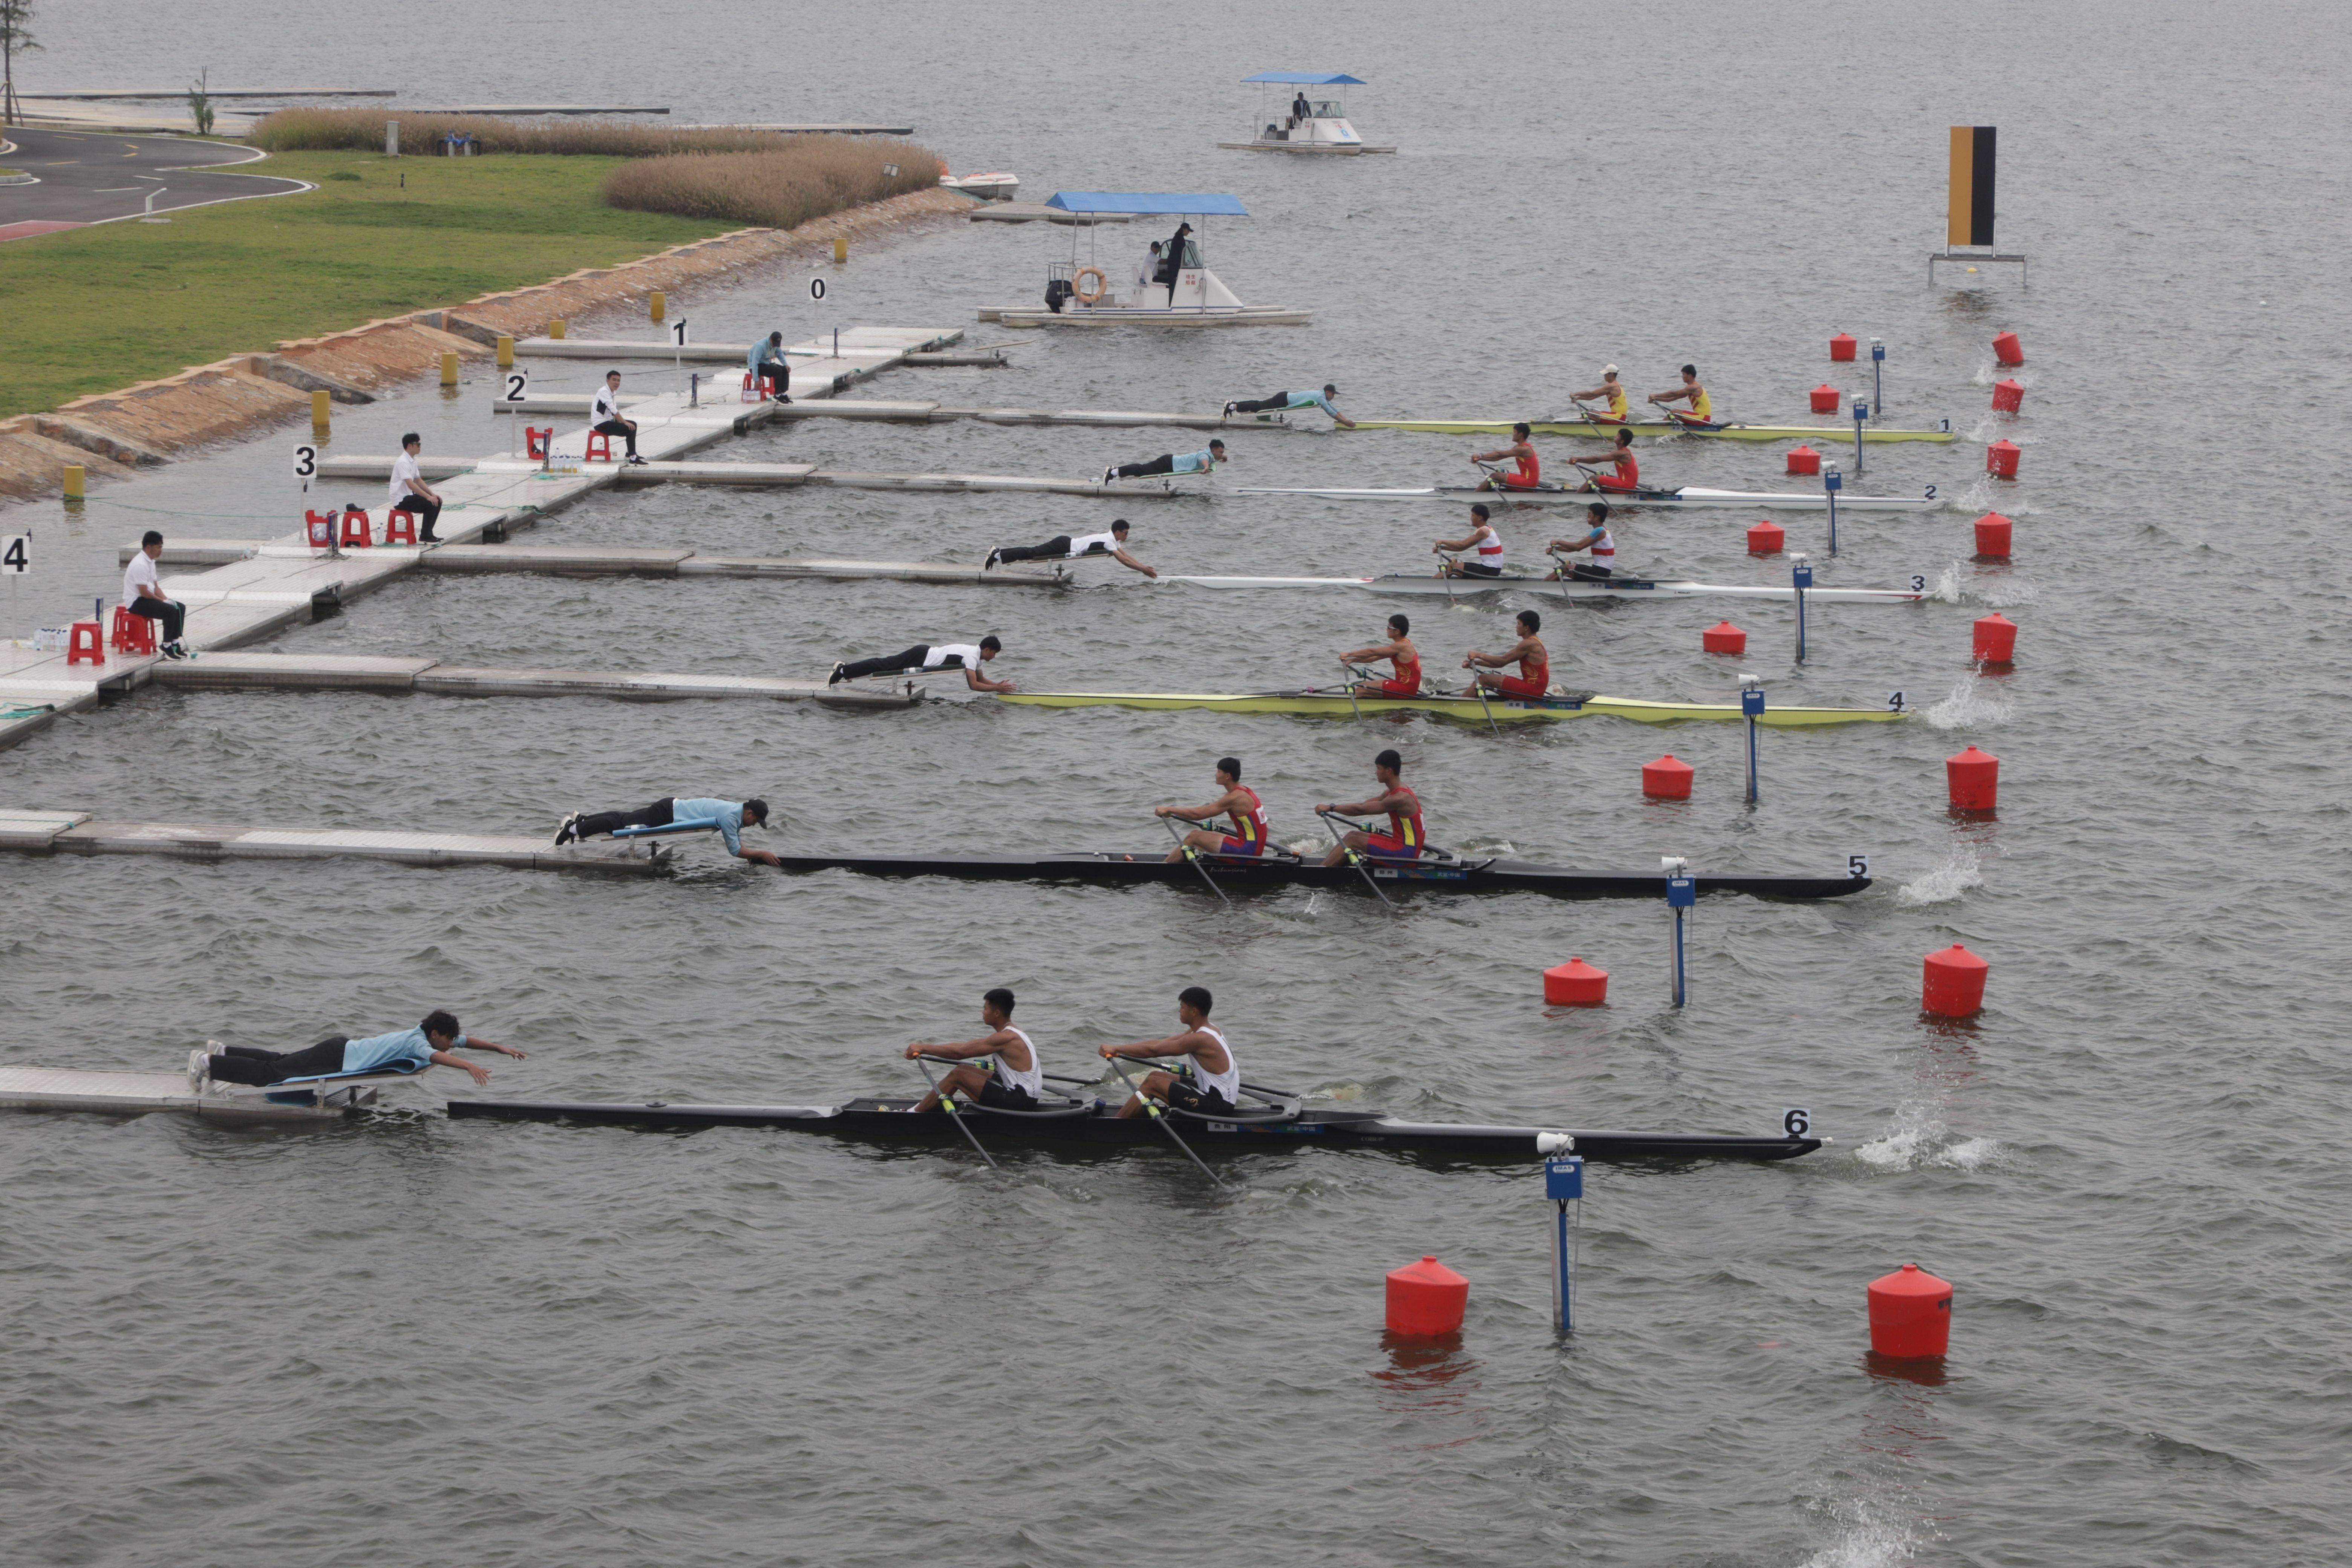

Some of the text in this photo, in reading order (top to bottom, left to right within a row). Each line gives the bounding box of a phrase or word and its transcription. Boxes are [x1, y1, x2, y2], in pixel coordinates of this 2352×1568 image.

[812, 279, 825, 299] 0
[674, 323, 684, 346] 1
[508, 376, 524, 401] 2
[1941, 419, 1949, 430] 1
[296, 447, 314, 475] 3
[1925, 485, 1936, 498] 2
[4, 539, 28, 572] 4
[1911, 576, 1925, 590] 3
[1889, 692, 1905, 709] 4
[1849, 856, 1867, 875] 5
[1784, 1110, 1808, 1135] 6
